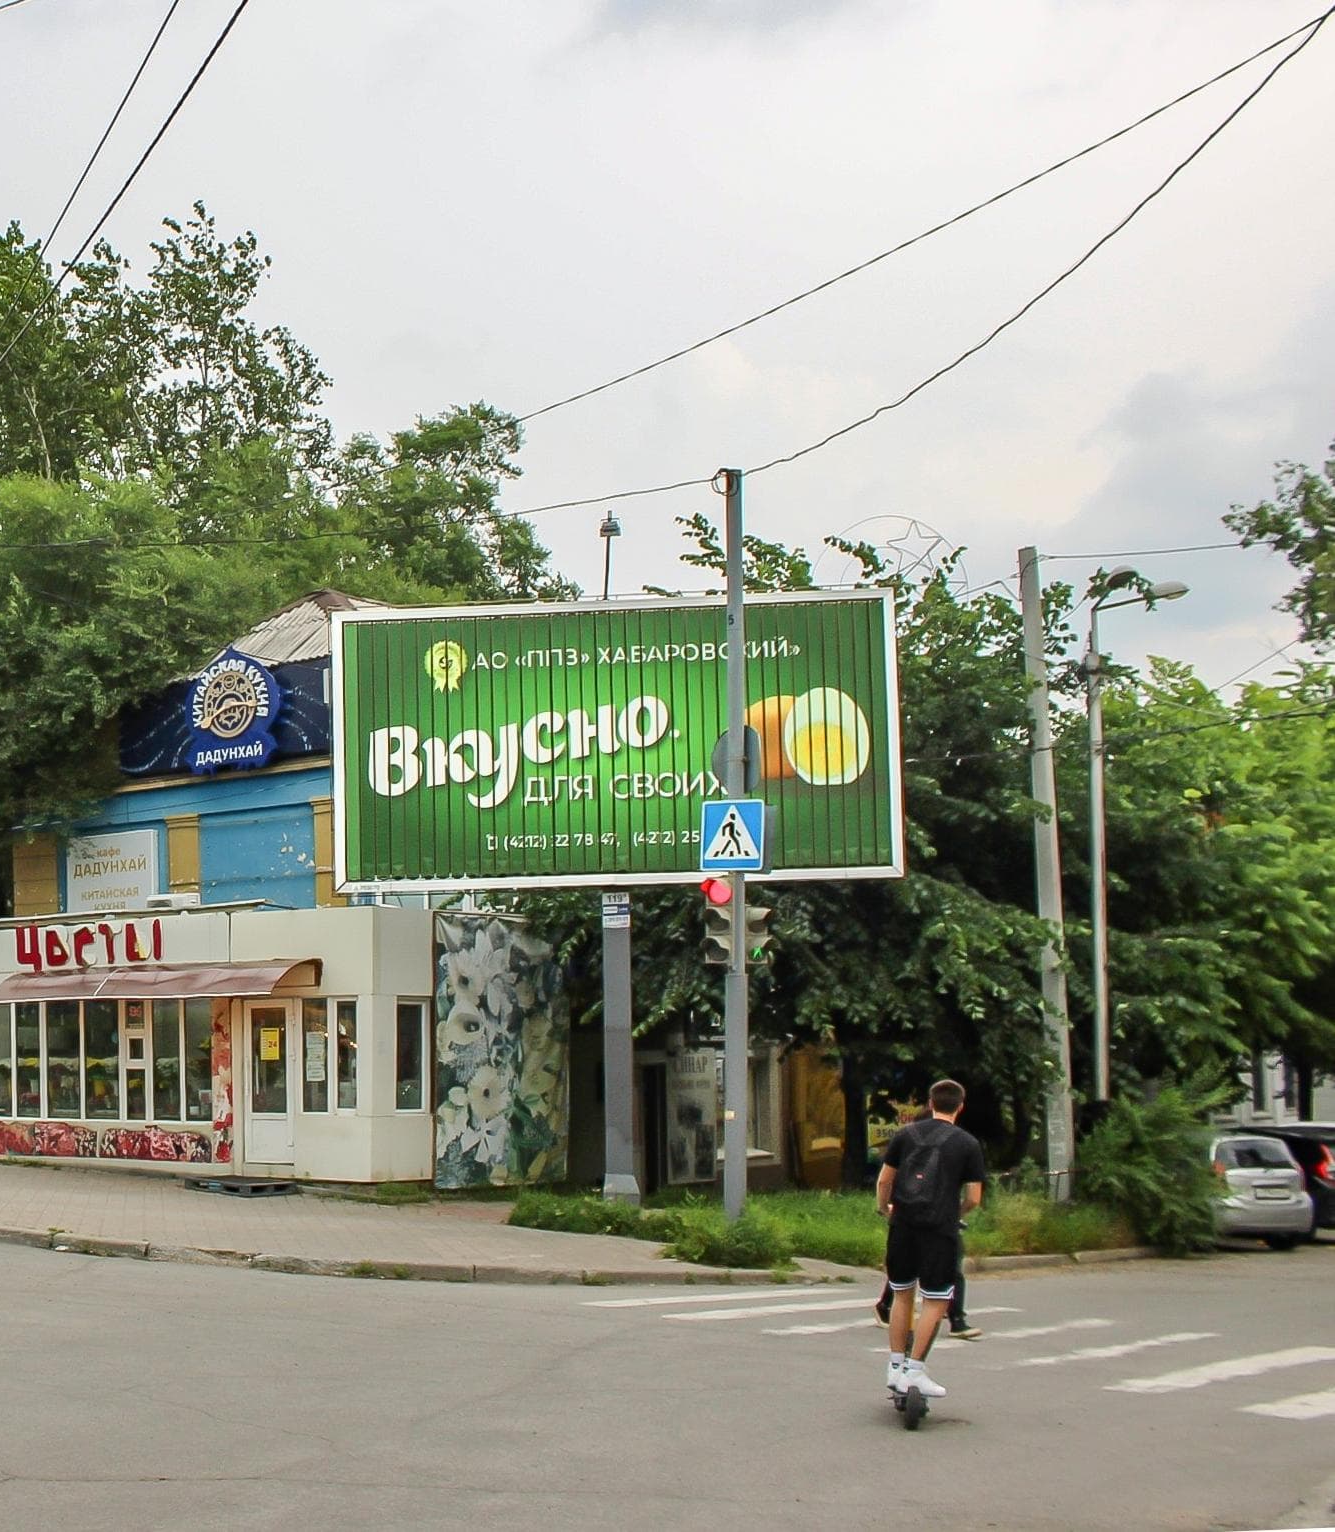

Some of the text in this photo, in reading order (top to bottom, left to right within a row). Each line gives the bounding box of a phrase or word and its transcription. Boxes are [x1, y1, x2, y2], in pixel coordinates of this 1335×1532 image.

[192, 659, 270, 728] КИТАЙСКАЯ КУХНЯ
[195, 740, 264, 767] ДАДУНХАЙ
[523, 769, 729, 807] ДЛЯ СВОИХ
[72, 852, 148, 880] ДАДУНХАЙ
[81, 886, 140, 902] КИТАЙСКАЯ
